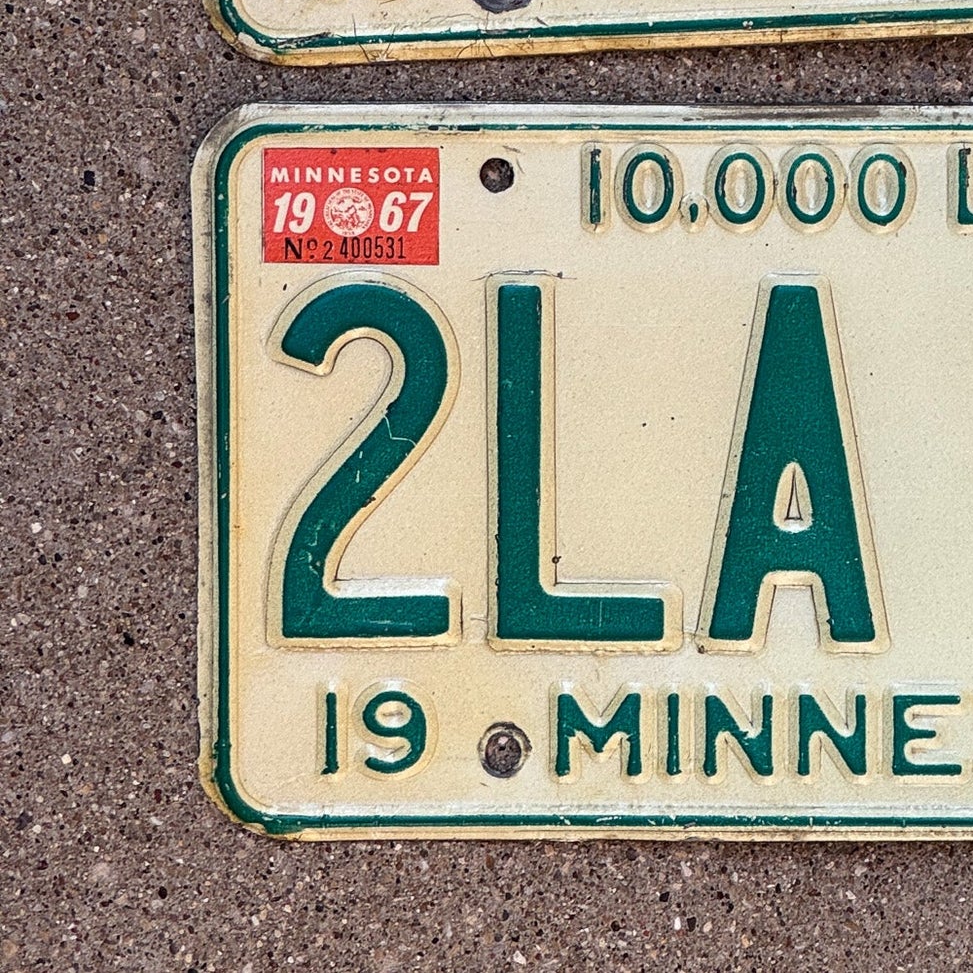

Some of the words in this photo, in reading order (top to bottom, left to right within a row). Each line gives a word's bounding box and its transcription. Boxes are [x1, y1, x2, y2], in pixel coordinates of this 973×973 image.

[269, 166, 434, 183] MINNESOTA
[272, 191, 317, 235] 19
[378, 190, 434, 234] 67
[279, 282, 878, 645] 2LA
[322, 691, 428, 776] 19
